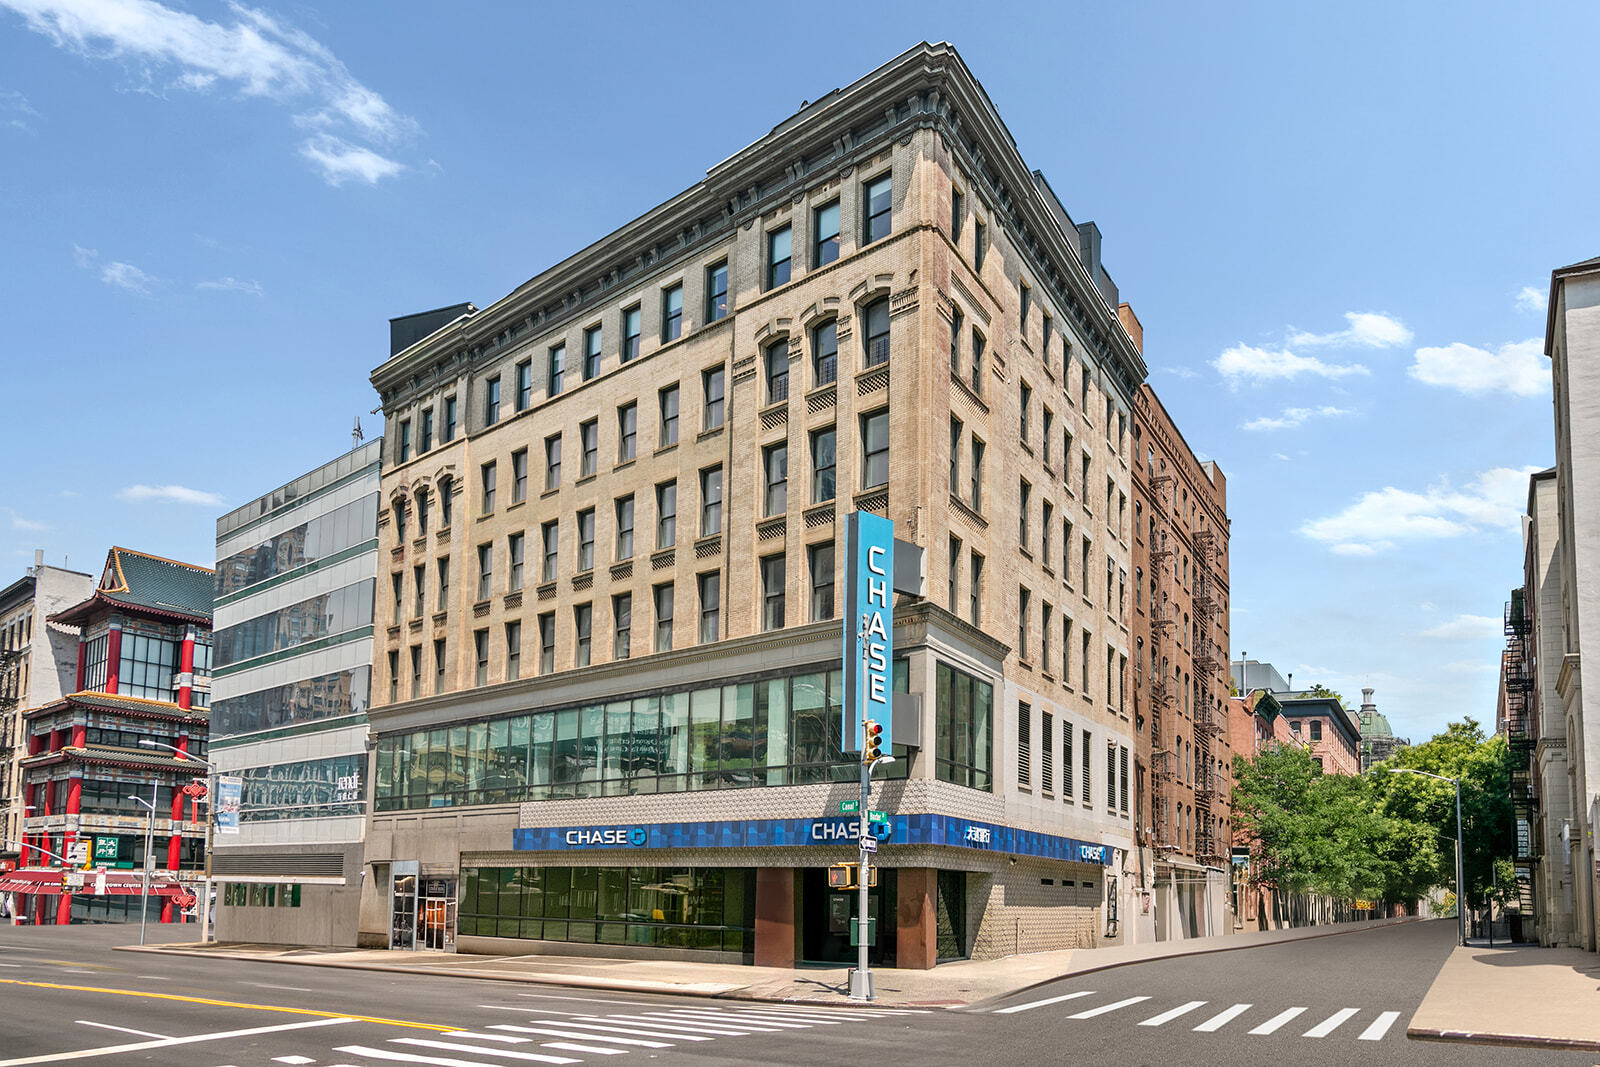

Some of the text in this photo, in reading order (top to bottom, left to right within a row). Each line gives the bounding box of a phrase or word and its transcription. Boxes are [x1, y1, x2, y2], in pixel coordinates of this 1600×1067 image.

[867, 545, 888, 704] CHASE
[566, 830, 628, 845] CHASE
[812, 822, 871, 840] CHAS
[1081, 845, 1101, 861] CHASE
